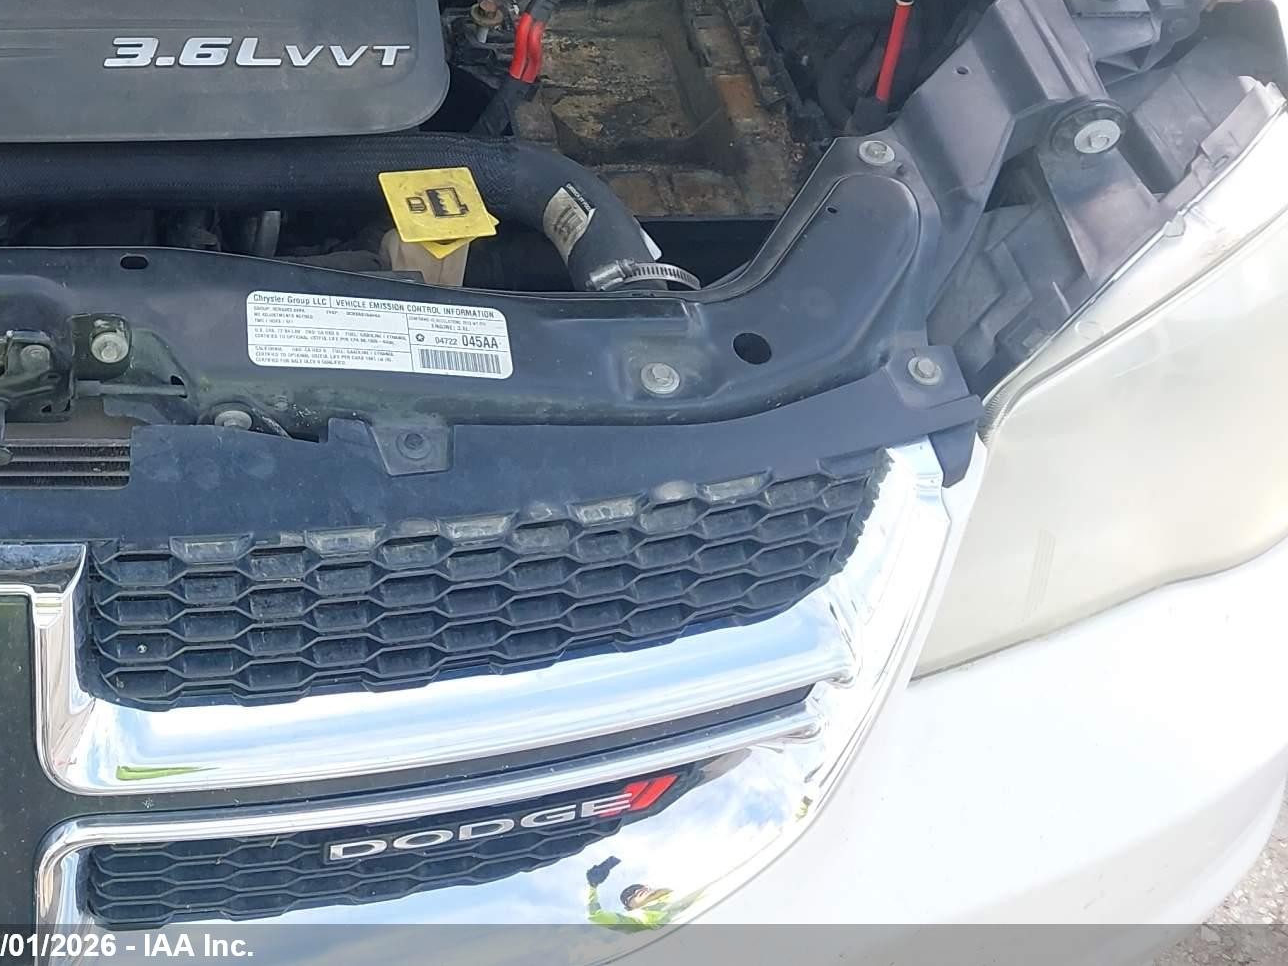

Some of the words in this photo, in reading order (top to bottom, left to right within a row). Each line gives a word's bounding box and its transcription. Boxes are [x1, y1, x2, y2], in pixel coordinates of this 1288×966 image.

[103, 37, 282, 67] 3.6L
[285, 45, 411, 67] VVT
[253, 294, 285, 304] Chrysler
[287, 296, 312, 307] Group
[312, 298, 327, 306] LLC
[336, 299, 367, 309] VEHICLE
[369, 302, 404, 312] EMISSION
[406, 304, 441, 315] CONTROL
[443, 307, 495, 319] INFORMATION
[434, 336, 458, 346] 04722
[462, 335, 499, 349] 045AA
[329, 791, 633, 862] DODGE
